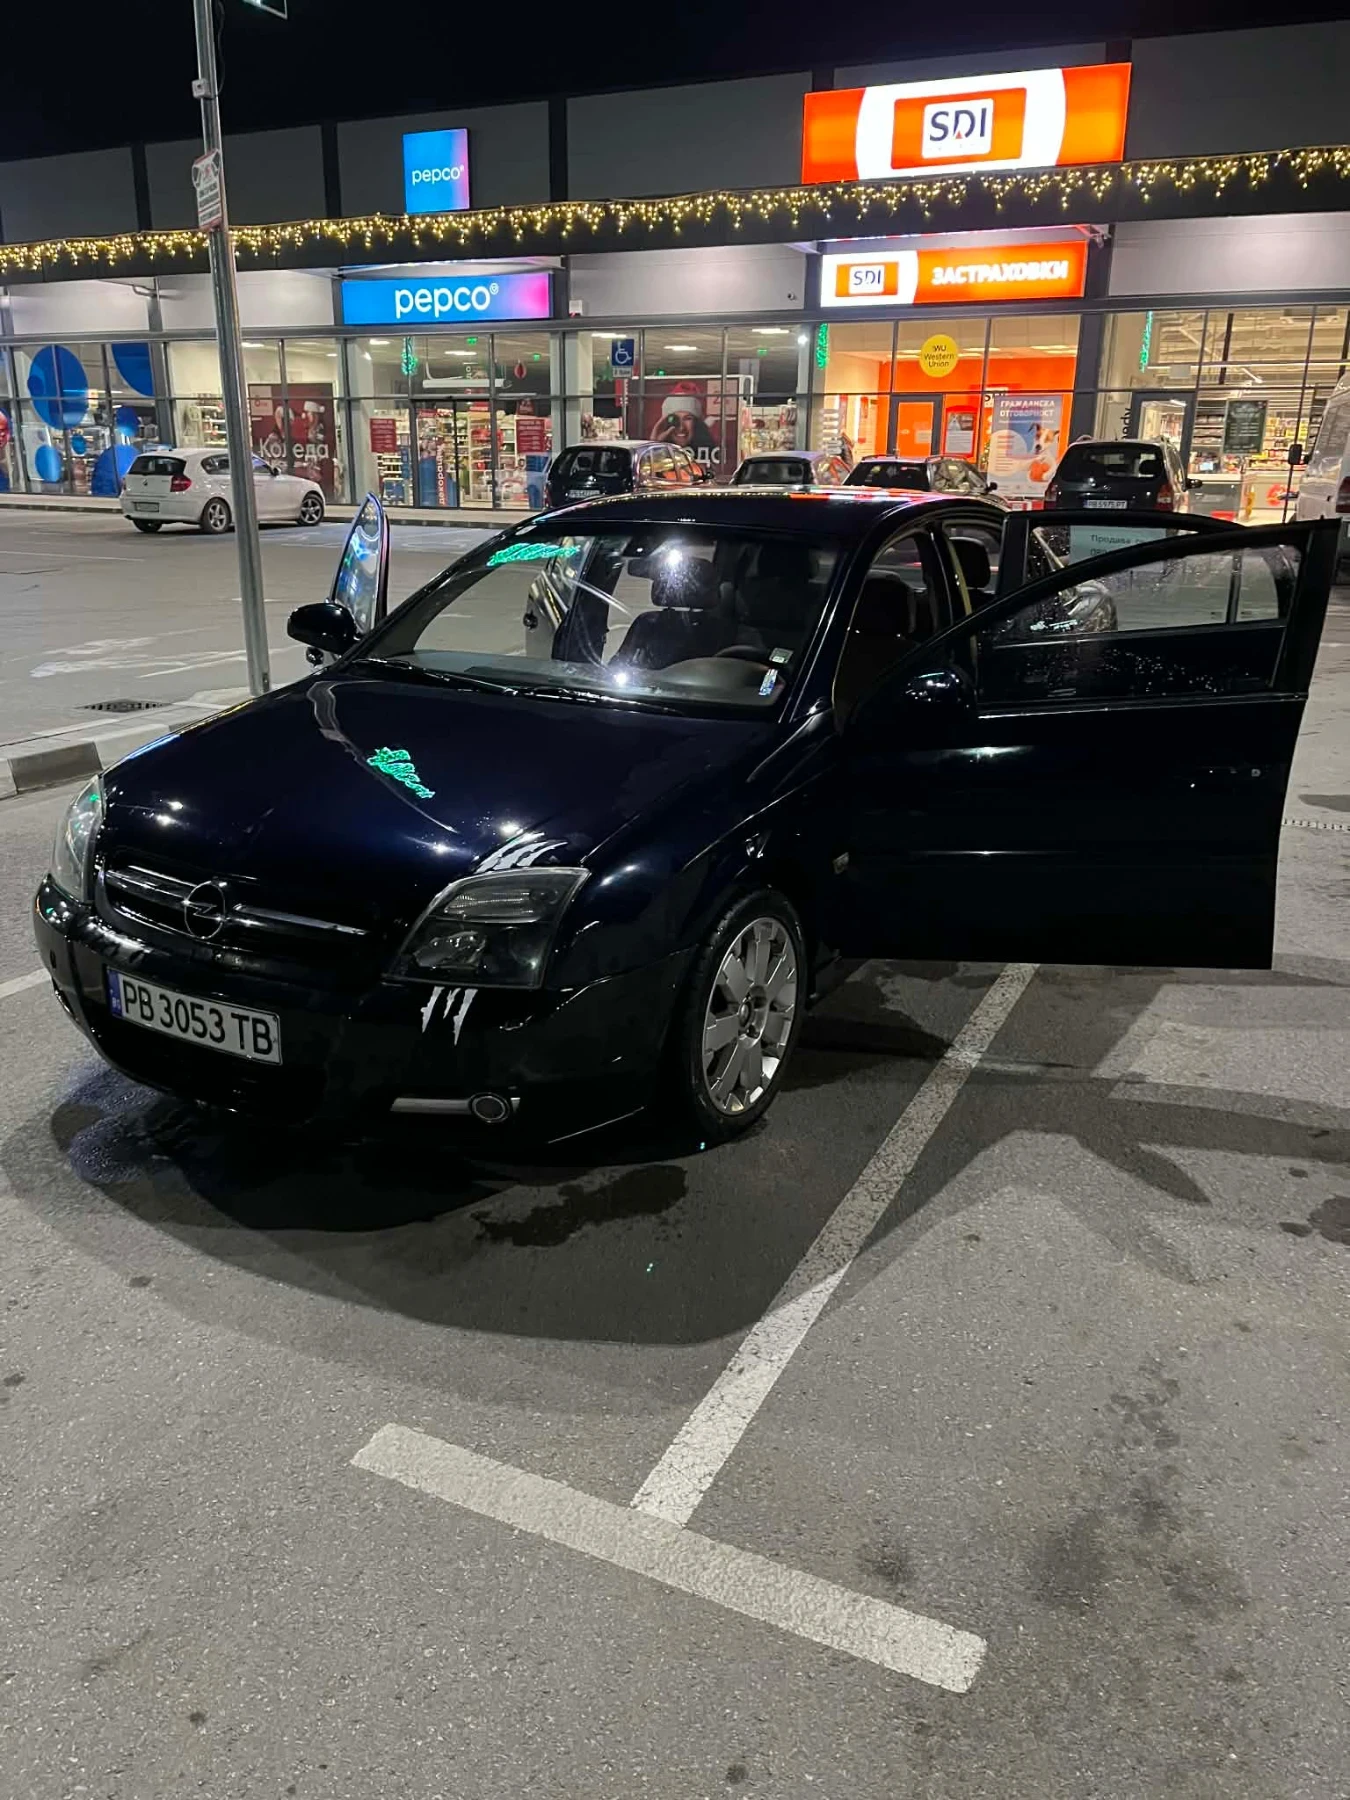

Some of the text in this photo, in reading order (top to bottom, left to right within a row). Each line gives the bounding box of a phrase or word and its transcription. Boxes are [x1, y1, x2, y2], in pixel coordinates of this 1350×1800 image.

[929, 107, 987, 142] SDI
[853, 270, 882, 286] SDI
[931, 260, 1069, 286] ЗАСТРАХОВКИ
[1000, 400, 1056, 409] ГРАЖДАНСКА
[122, 979, 273, 1056] PB 3053 TB
